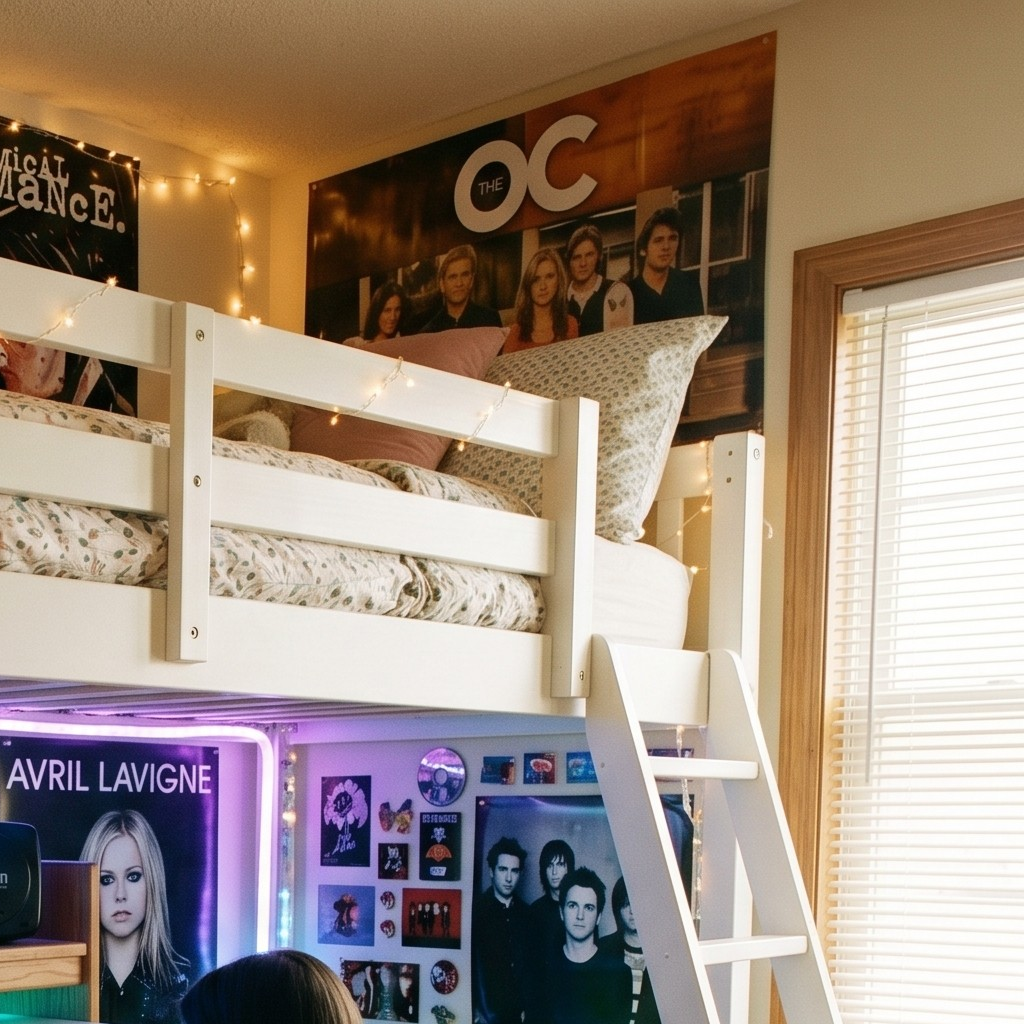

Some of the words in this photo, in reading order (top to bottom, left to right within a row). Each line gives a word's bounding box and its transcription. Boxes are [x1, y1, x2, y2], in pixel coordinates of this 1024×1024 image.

[454, 114, 598, 233] OC
[478, 176, 504, 196] THE
[6, 758, 90, 792] AVRIL
[99, 761, 212, 794] LAVIGNE
